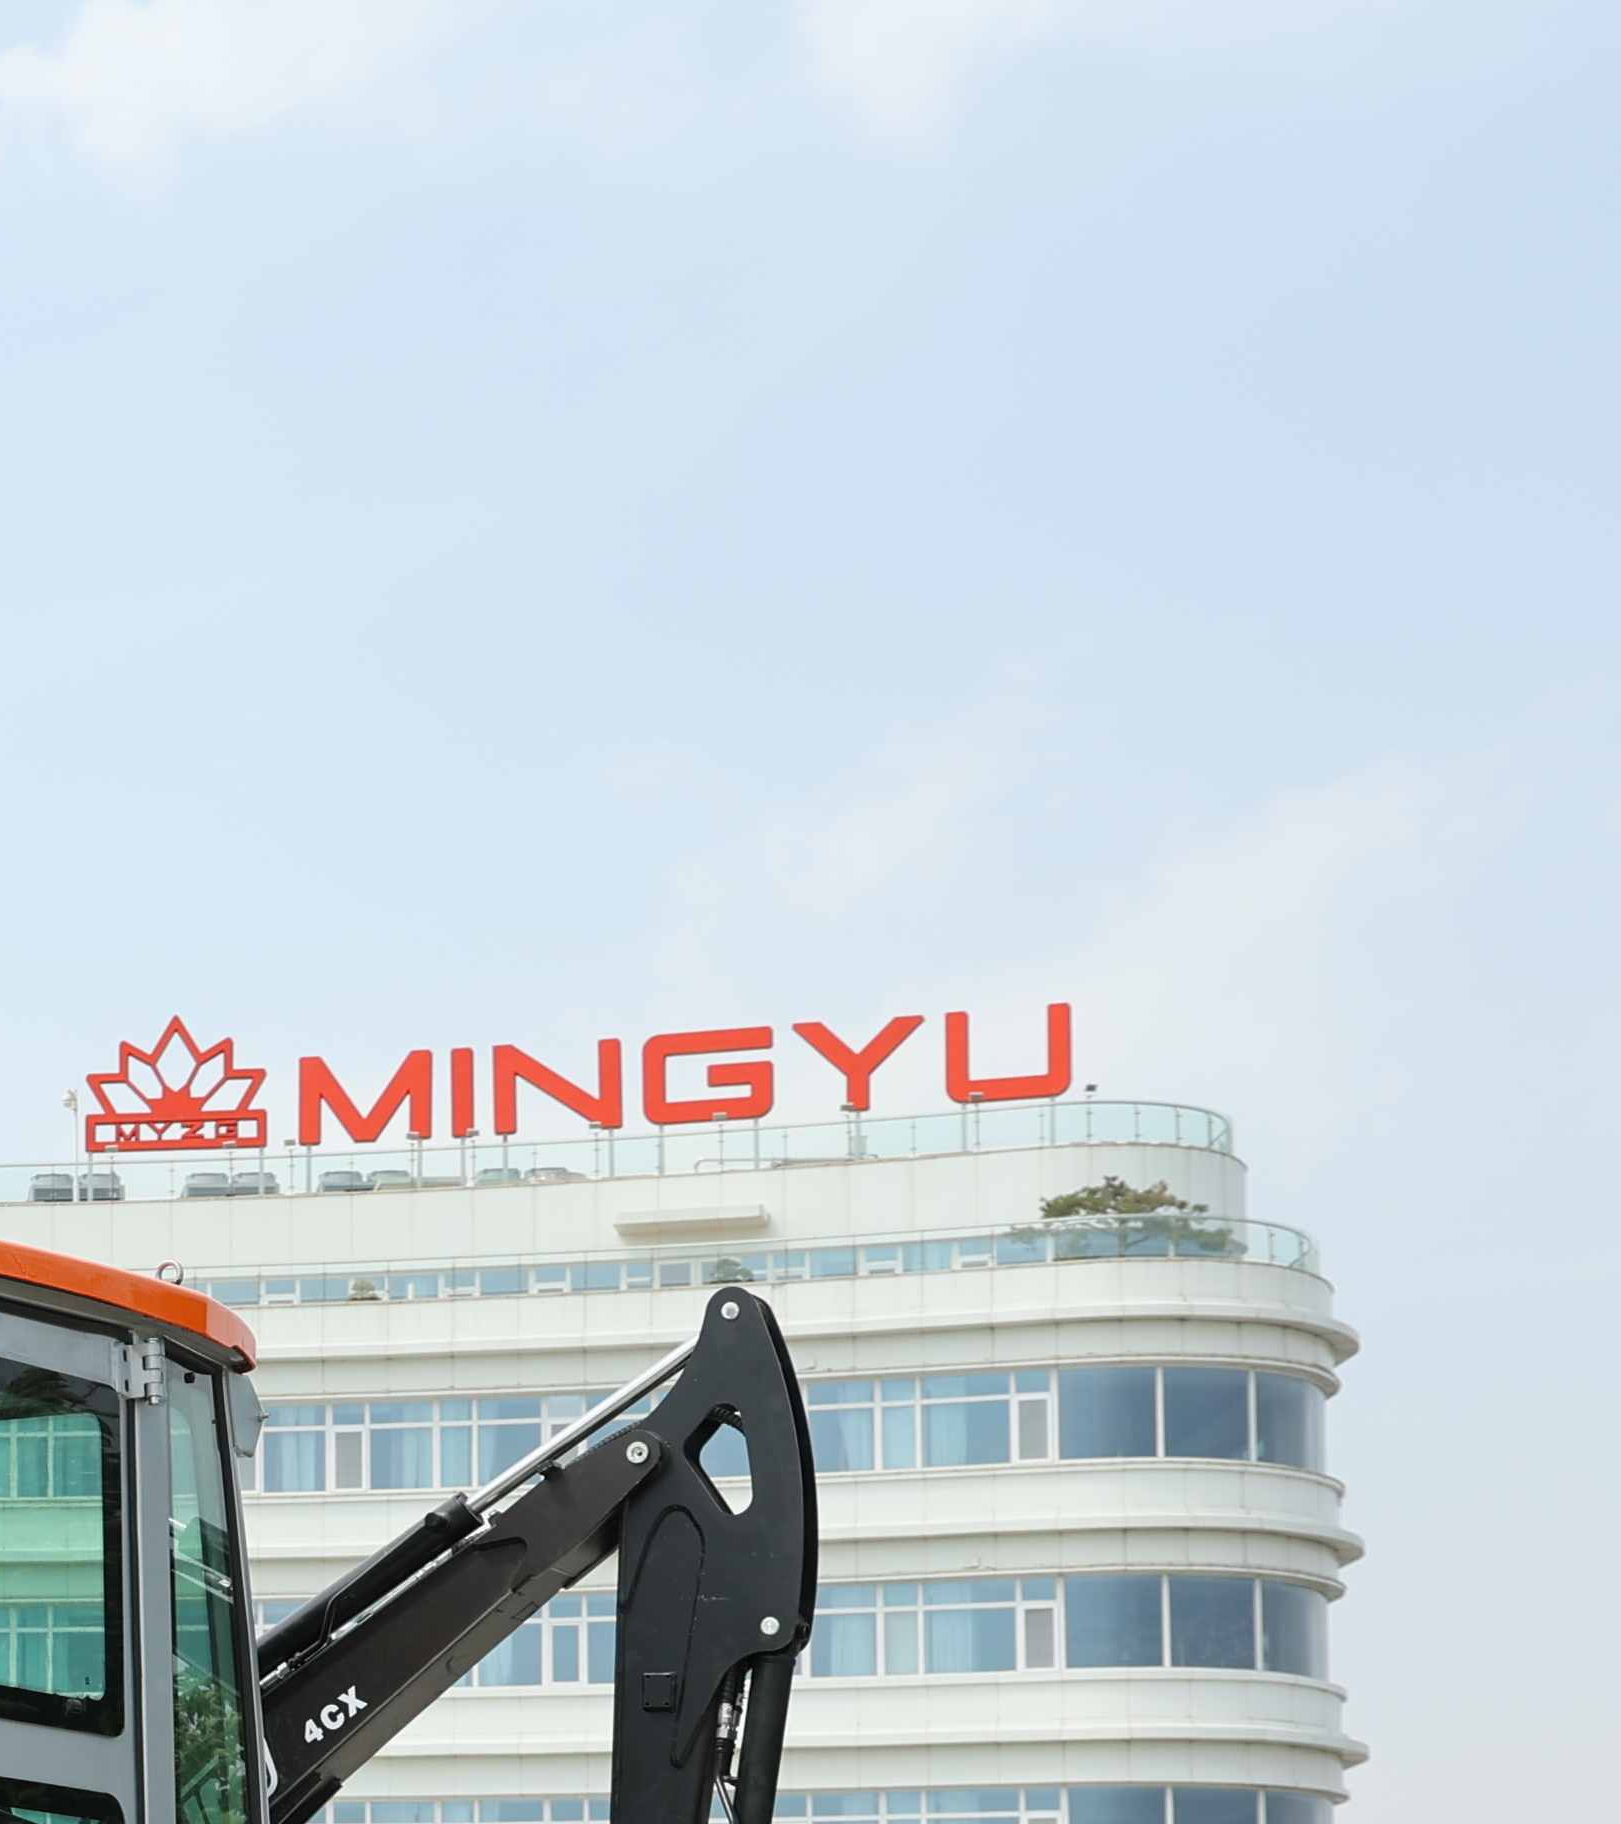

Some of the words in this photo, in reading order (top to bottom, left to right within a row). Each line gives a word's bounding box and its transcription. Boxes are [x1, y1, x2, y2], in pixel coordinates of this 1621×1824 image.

[298, 1002, 1073, 1146] MINGYU
[116, 1117, 239, 1144] MYZG
[303, 1684, 369, 1745] 4CX
